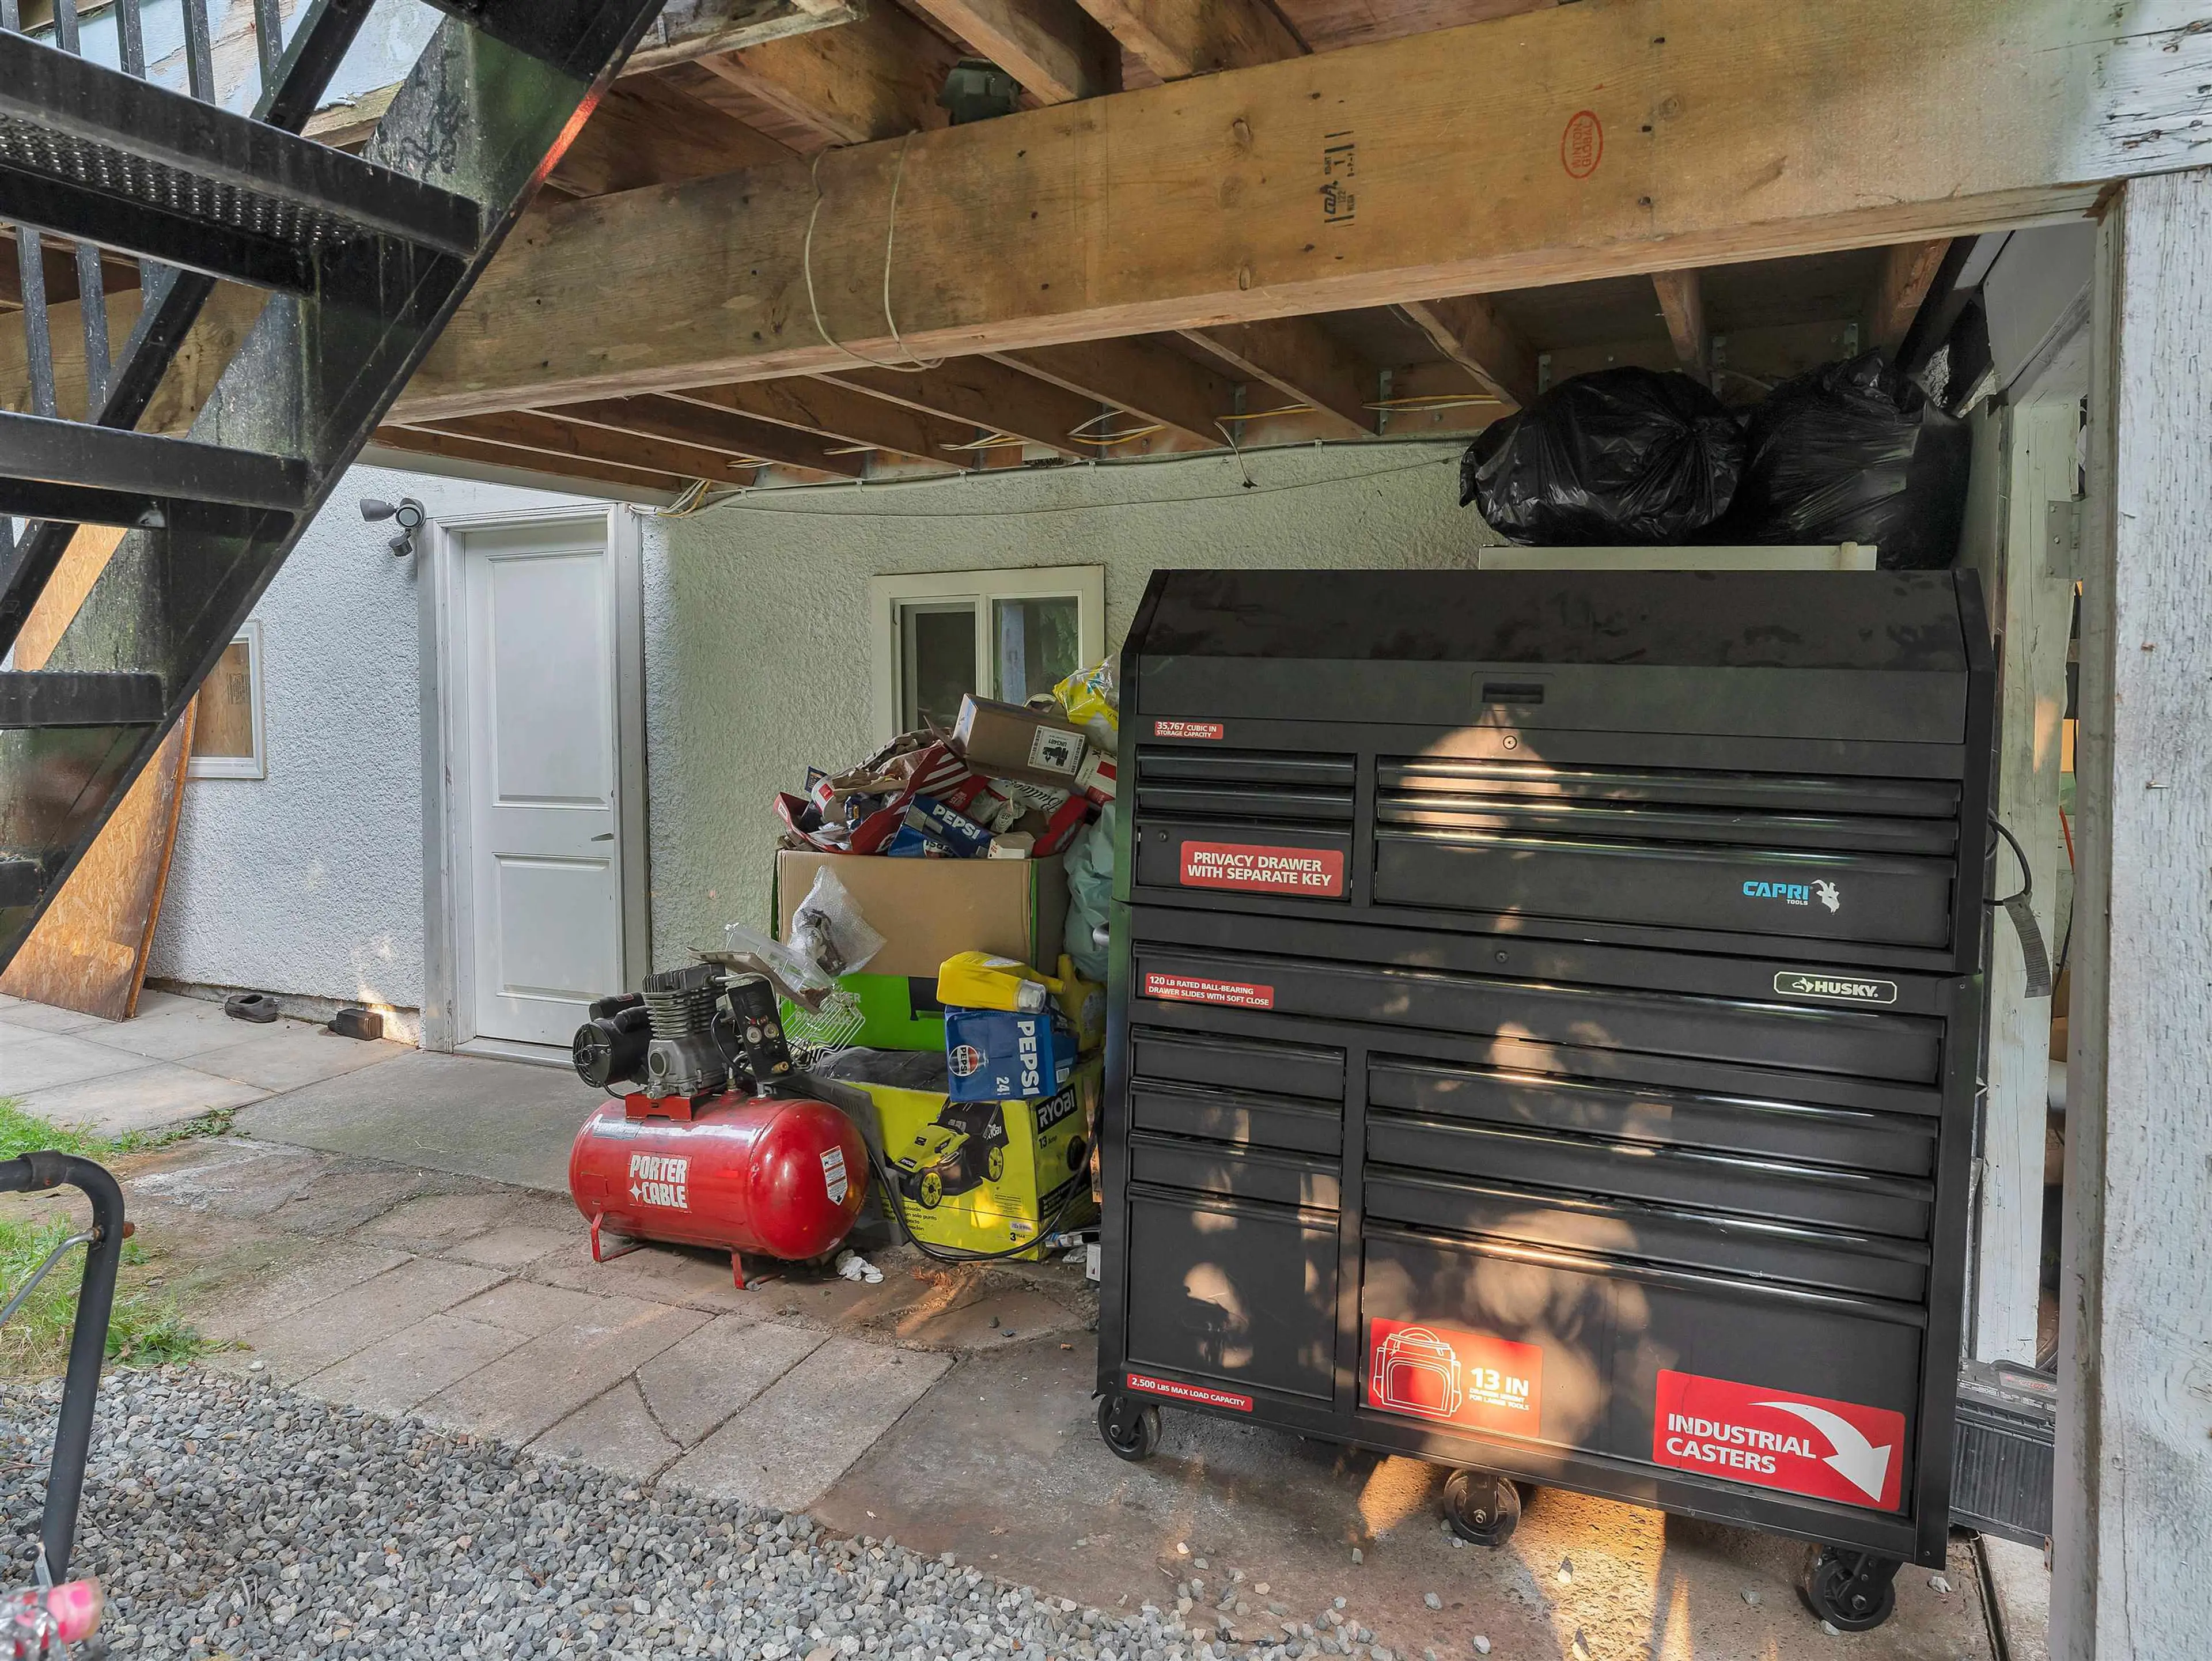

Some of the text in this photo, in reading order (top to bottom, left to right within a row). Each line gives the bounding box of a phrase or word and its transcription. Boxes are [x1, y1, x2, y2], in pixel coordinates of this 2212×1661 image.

[1571, 123, 1582, 168] WINTON
[1582, 121, 1593, 167] GLOBAL
[1157, 721, 1185, 731] 35,767
[932, 804, 981, 840] PEPSI
[1188, 865, 1332, 887] WITH SEPARATE KEY
[1194, 852, 1321, 872] PRIVACY DRAWER
[1743, 881, 1809, 901] CAPRI
[1149, 976, 1165, 985] 120
[1176, 980, 1200, 989] RATED
[1202, 983, 1253, 995] BALL-BEARING
[1149, 986, 1269, 1006] DRAWER SLIDES WITH SOFT CLOSE
[960, 1046, 968, 1074] PEPSI
[1017, 1020, 1040, 1095] PEPSI
[1038, 1089, 1075, 1127] RYOBI
[1038, 1135, 1047, 1149] 13
[629, 1155, 688, 1184] PORTER
[1009, 1232, 1017, 1242] 3
[1131, 1378, 1245, 1407] 2,500 LBS MAX LOAD CAPACITY
[1470, 1367, 1529, 1397] 13 IN
[1668, 1413, 1816, 1459] INDUSTRIAL
[1666, 1437, 1776, 1474] CASTERS
